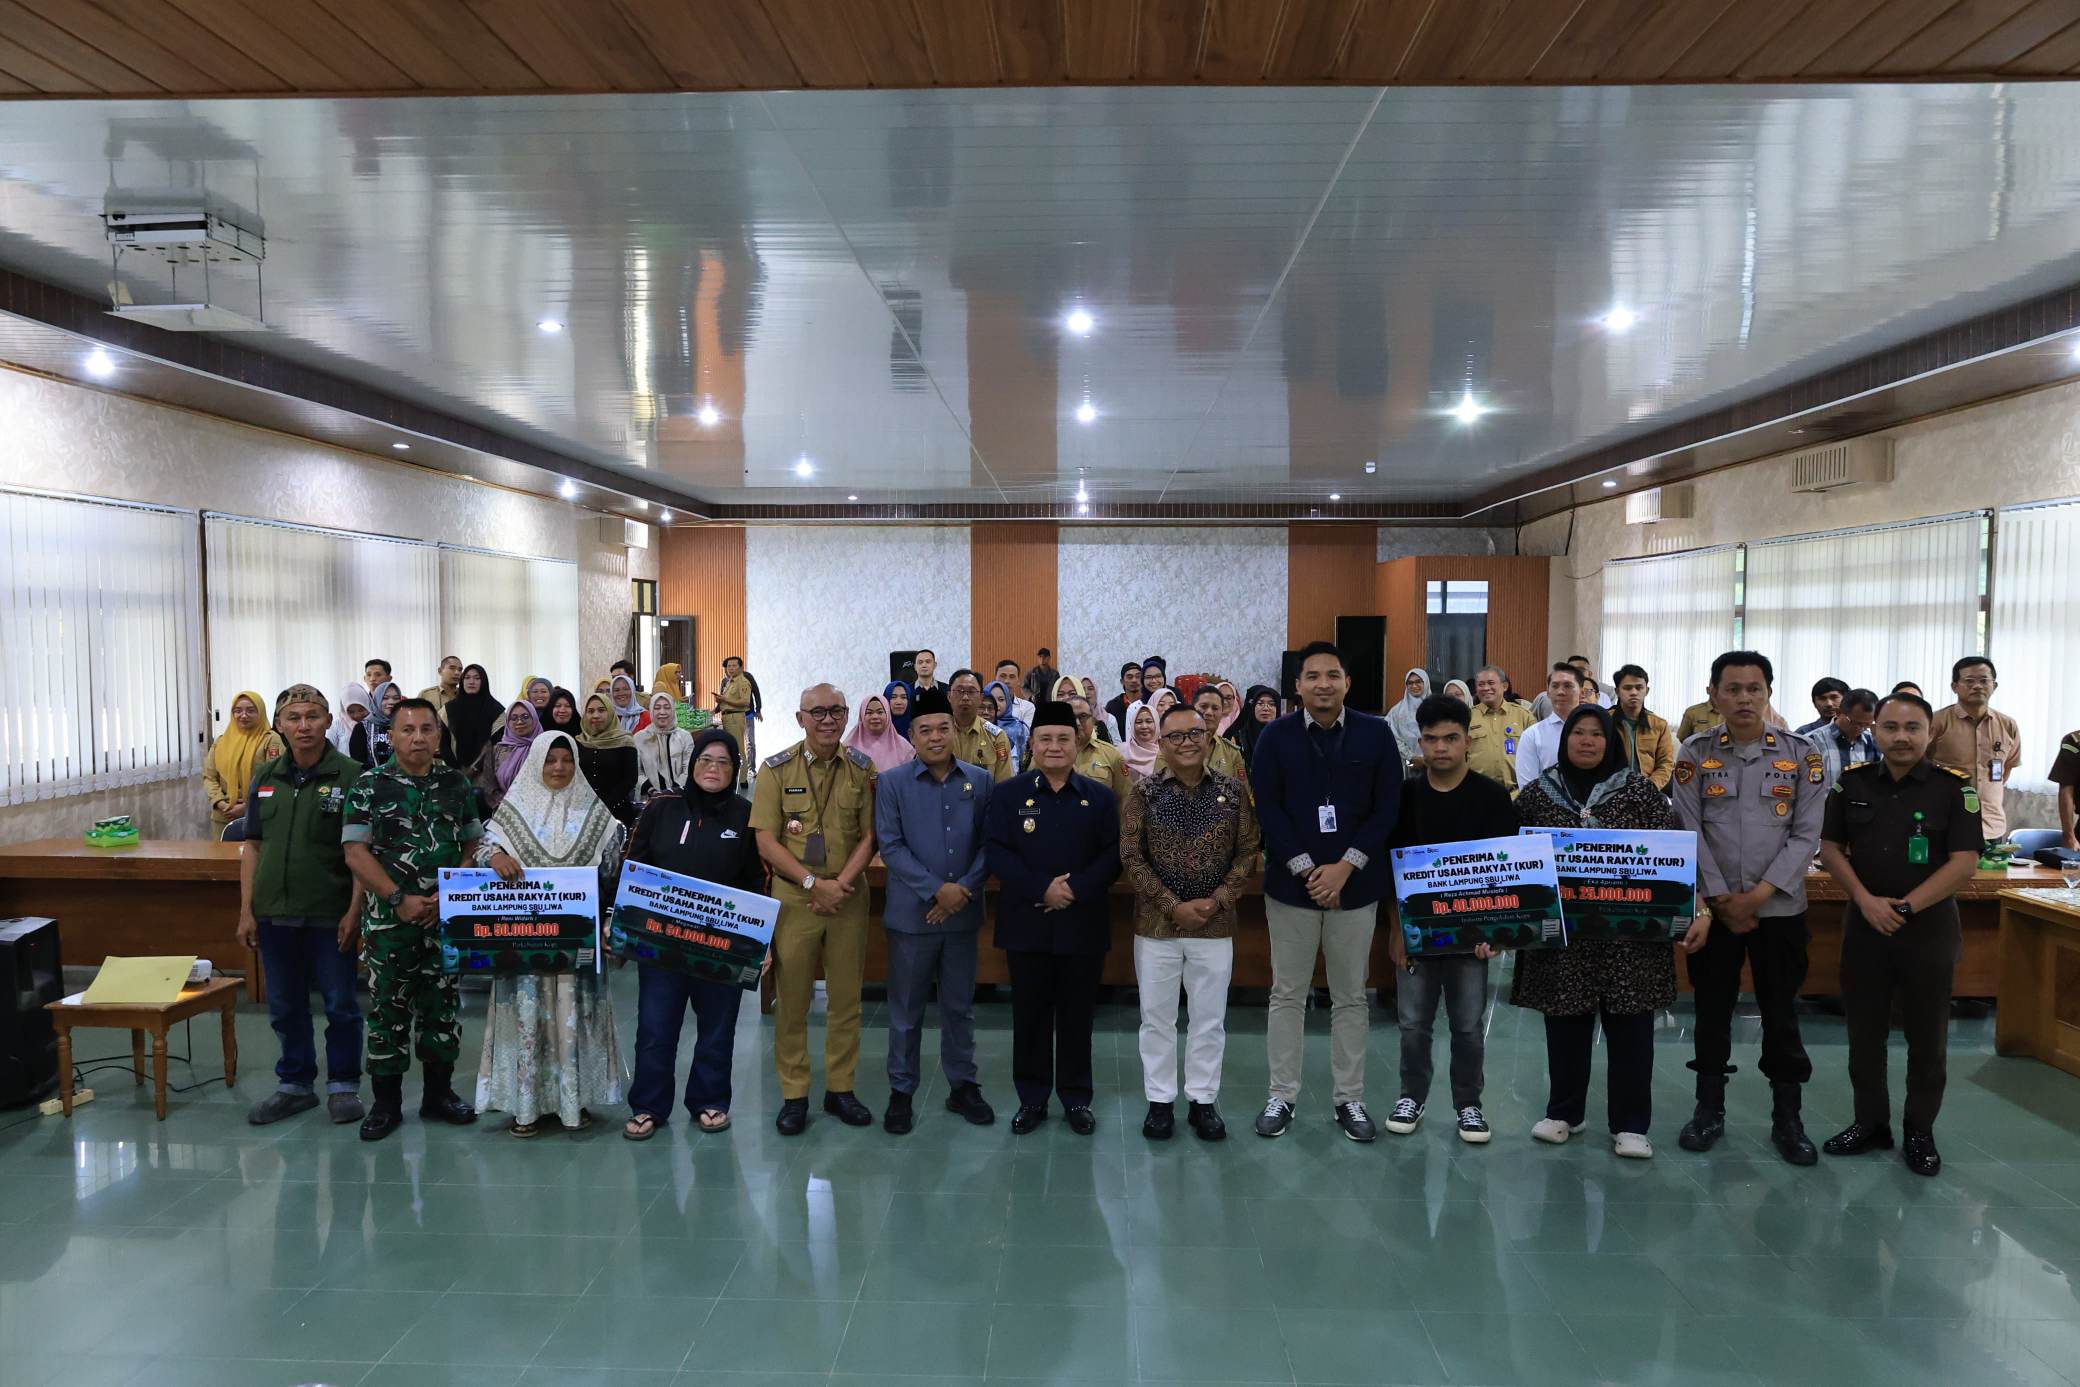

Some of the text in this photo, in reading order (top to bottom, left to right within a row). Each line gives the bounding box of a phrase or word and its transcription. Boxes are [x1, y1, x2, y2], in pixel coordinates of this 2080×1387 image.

[1575, 842, 1634, 853] PENERIMA
[1442, 852, 1495, 866] PENERIMA
[1568, 855, 1604, 864] USAHA
[1606, 855, 1652, 866] RAKYAT
[1653, 857, 1685, 867] (KUR)
[1403, 870, 1437, 881] KREDIT
[1438, 867, 1471, 878] USAHA
[1472, 863, 1513, 875] RAKYAT
[1514, 859, 1544, 872] (KUR)
[1578, 866, 1618, 874] LAMPUNG
[1618, 867, 1636, 875] SBU
[1636, 868, 1658, 876] LIWA
[489, 881, 541, 890] PENERIMA
[1427, 874, 1520, 888] BANK LAMPUNG SBU LIWA
[448, 891, 586, 902] KREDIT USAHA RAKYAT (KUR)
[671, 886, 723, 907] PENERIMA
[1579, 886, 1652, 903] 25.000.000
[528, 903, 543, 911] SBU
[544, 903, 563, 911] LIWA
[628, 884, 765, 928] KREDIT USAHA RAKYAT (KUR)
[1432, 894, 1519, 915] Rp. 40.000.000
[648, 901, 739, 931] BANK LAMPUNG SBU LIWA
[473, 923, 559, 938] Rp. 50.000.000
[645, 918, 731, 950] Rp. 50.000.000
